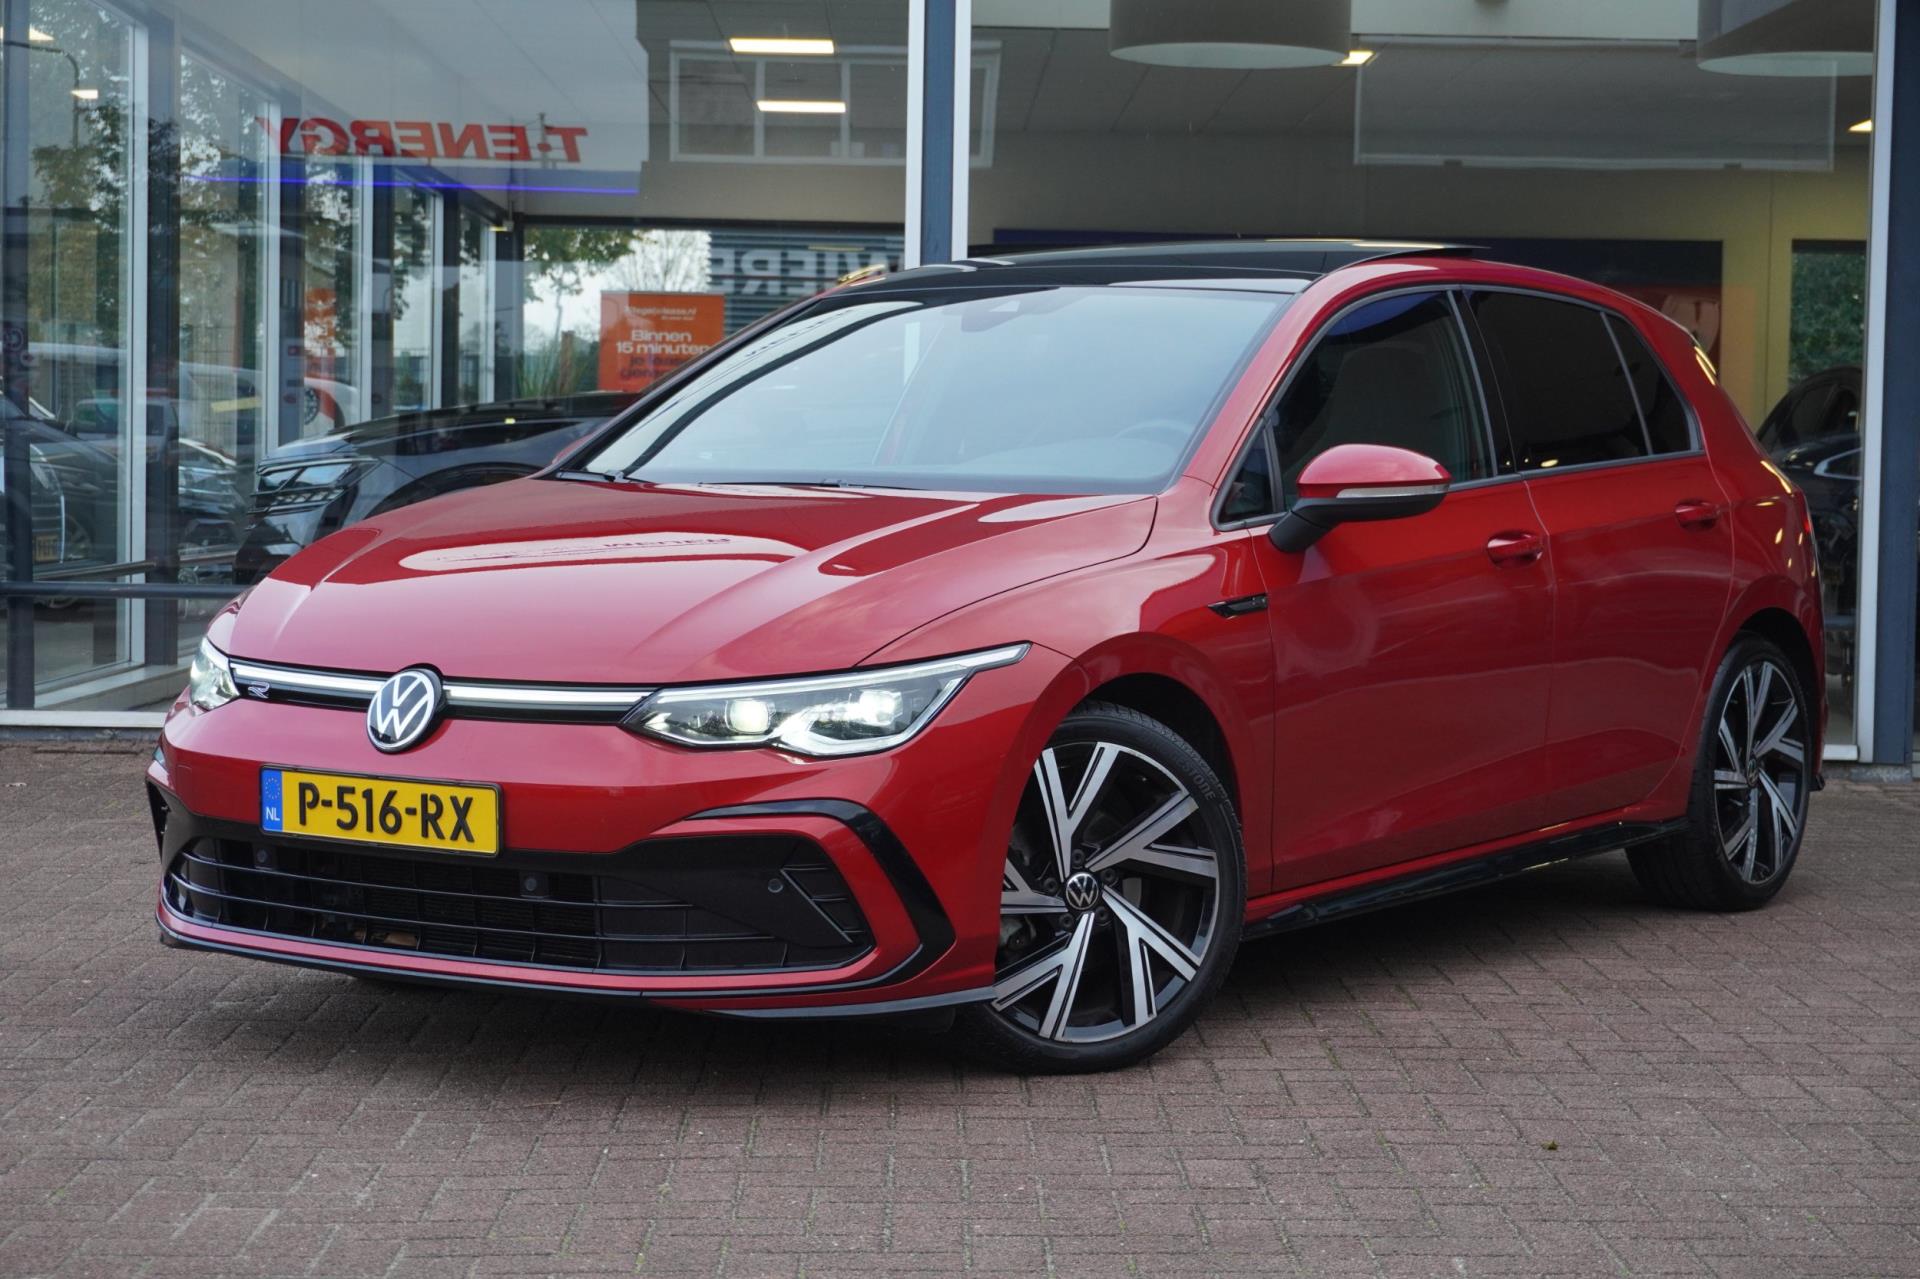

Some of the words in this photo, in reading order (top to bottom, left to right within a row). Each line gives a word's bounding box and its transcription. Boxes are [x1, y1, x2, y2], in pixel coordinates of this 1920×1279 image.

[631, 330, 692, 342] Binnen
[616, 341, 633, 354] 15
[637, 342, 711, 355] minuten
[265, 807, 281, 822] NL
[298, 781, 475, 843] P-516-RX
